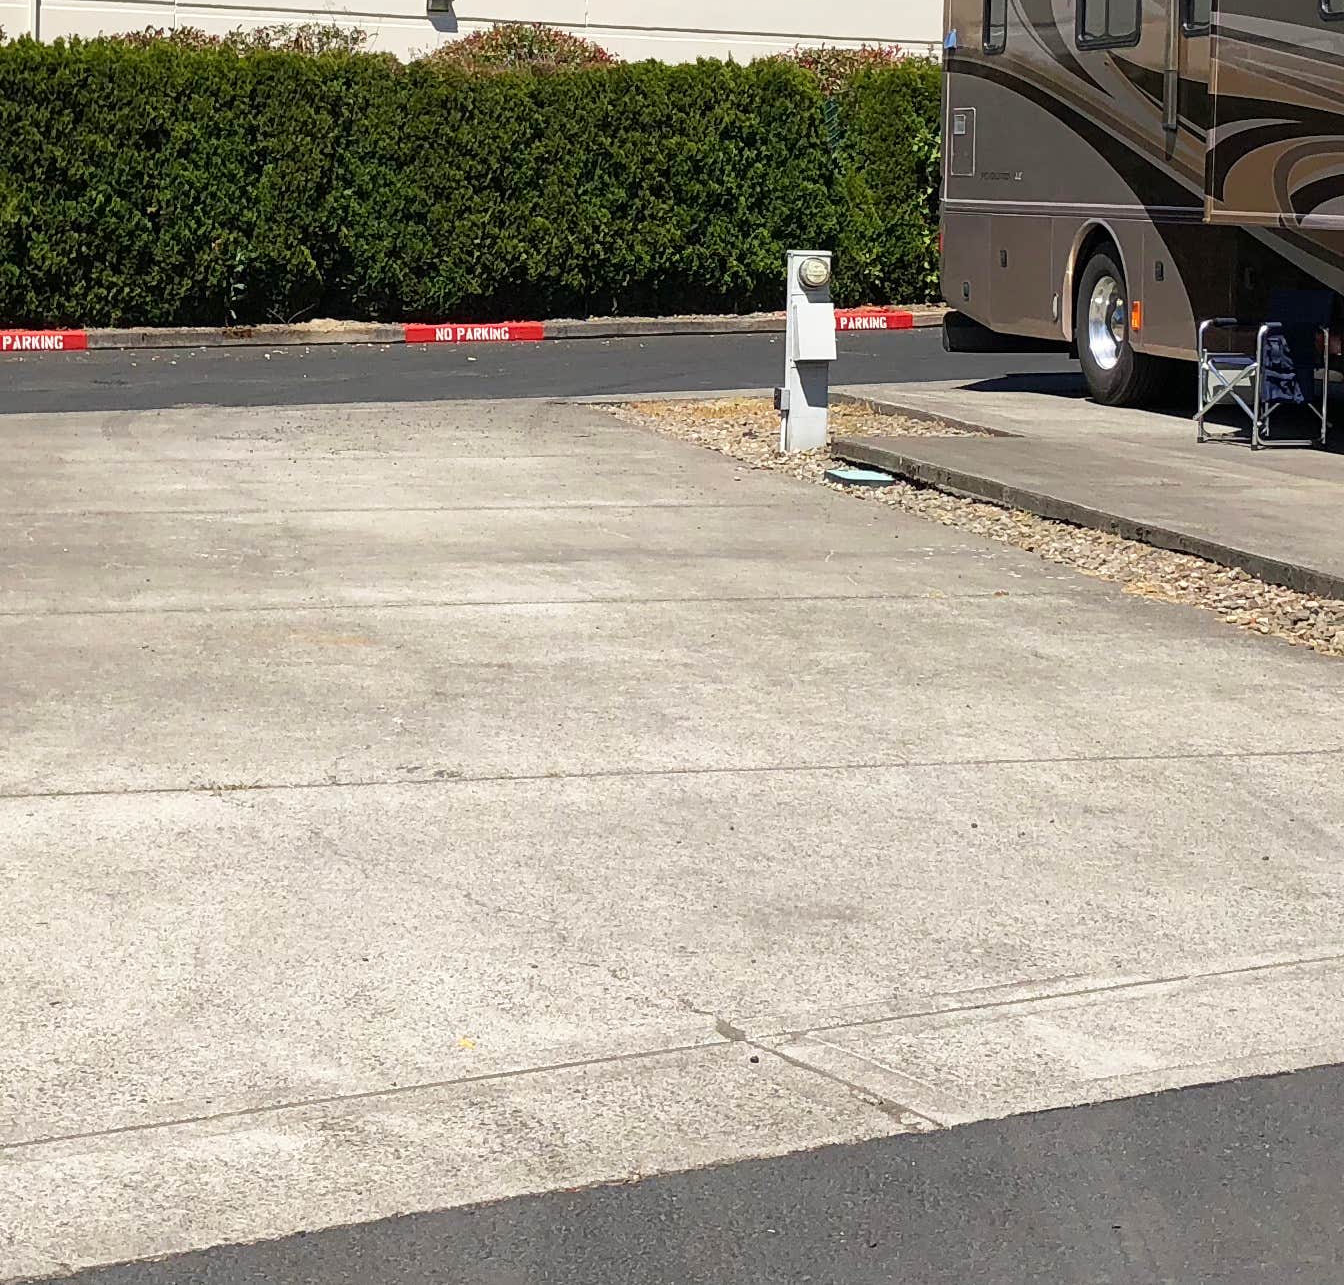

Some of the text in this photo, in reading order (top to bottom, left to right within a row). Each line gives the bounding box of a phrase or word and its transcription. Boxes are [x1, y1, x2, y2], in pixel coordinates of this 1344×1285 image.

[840, 316, 888, 329] PARKING
[436, 327, 509, 341] NO PARKING
[2, 335, 63, 350] PARKING
